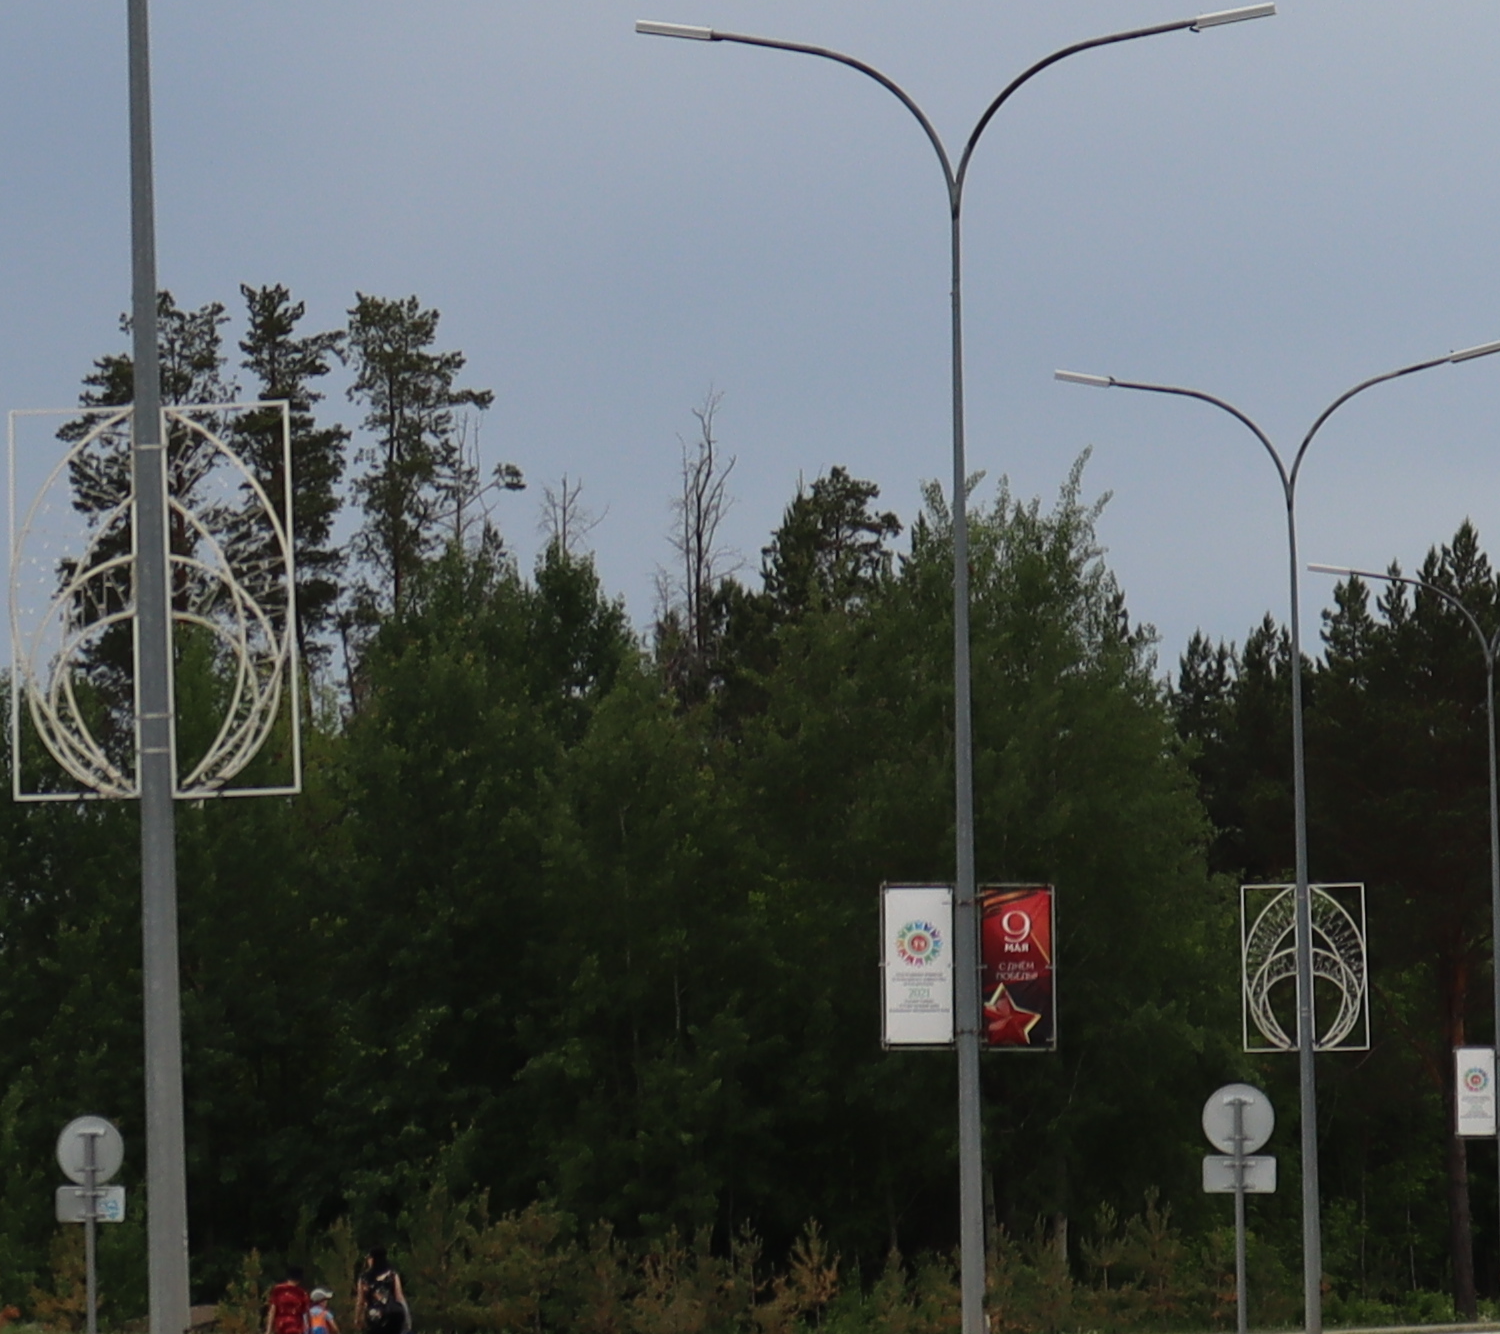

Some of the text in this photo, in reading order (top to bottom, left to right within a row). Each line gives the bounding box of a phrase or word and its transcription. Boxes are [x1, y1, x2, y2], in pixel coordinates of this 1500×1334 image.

[1002, 910, 1031, 943] 9
[1004, 943, 1029, 953] МАЯ
[998, 961, 1006, 971] С
[908, 988, 930, 998] 2021
